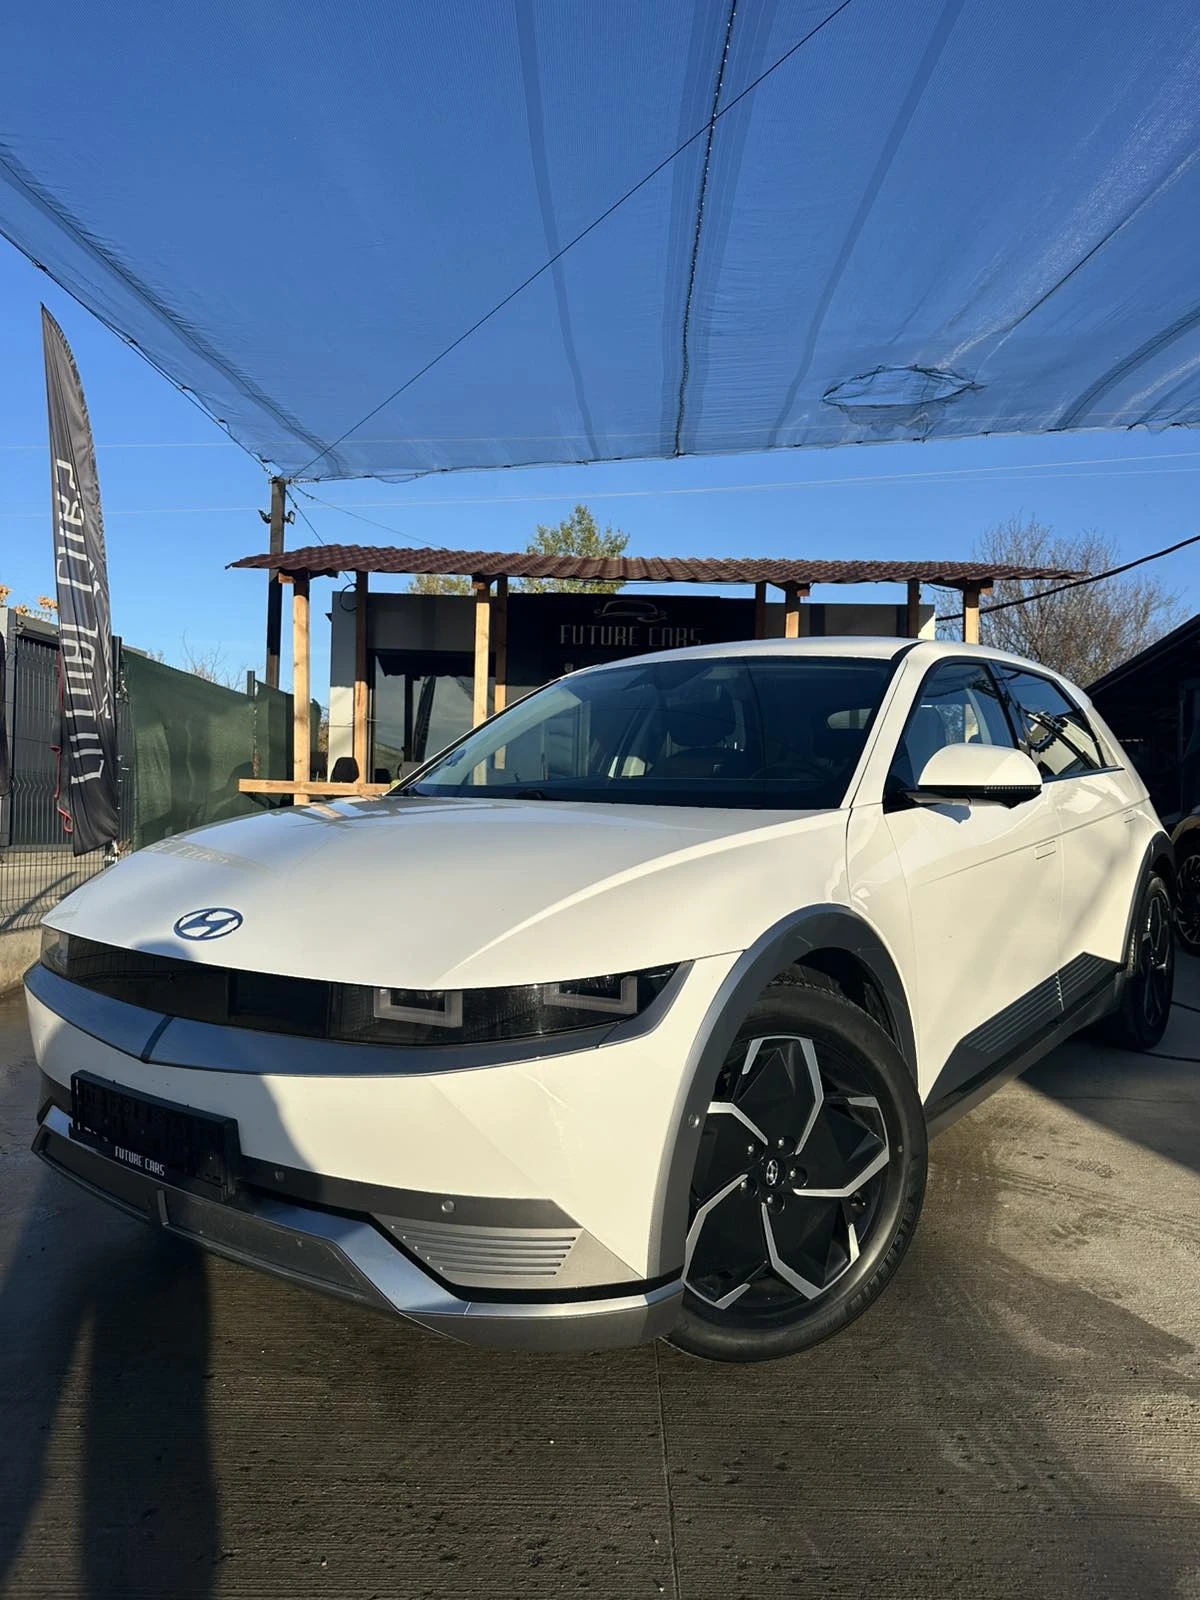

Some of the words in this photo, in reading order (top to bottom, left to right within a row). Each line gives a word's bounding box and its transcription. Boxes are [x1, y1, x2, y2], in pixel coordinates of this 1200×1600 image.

[559, 624, 640, 647] FUTURE
[648, 626, 704, 648] CARS
[115, 1145, 143, 1168] FUTURE
[144, 1157, 166, 1177] CARS
